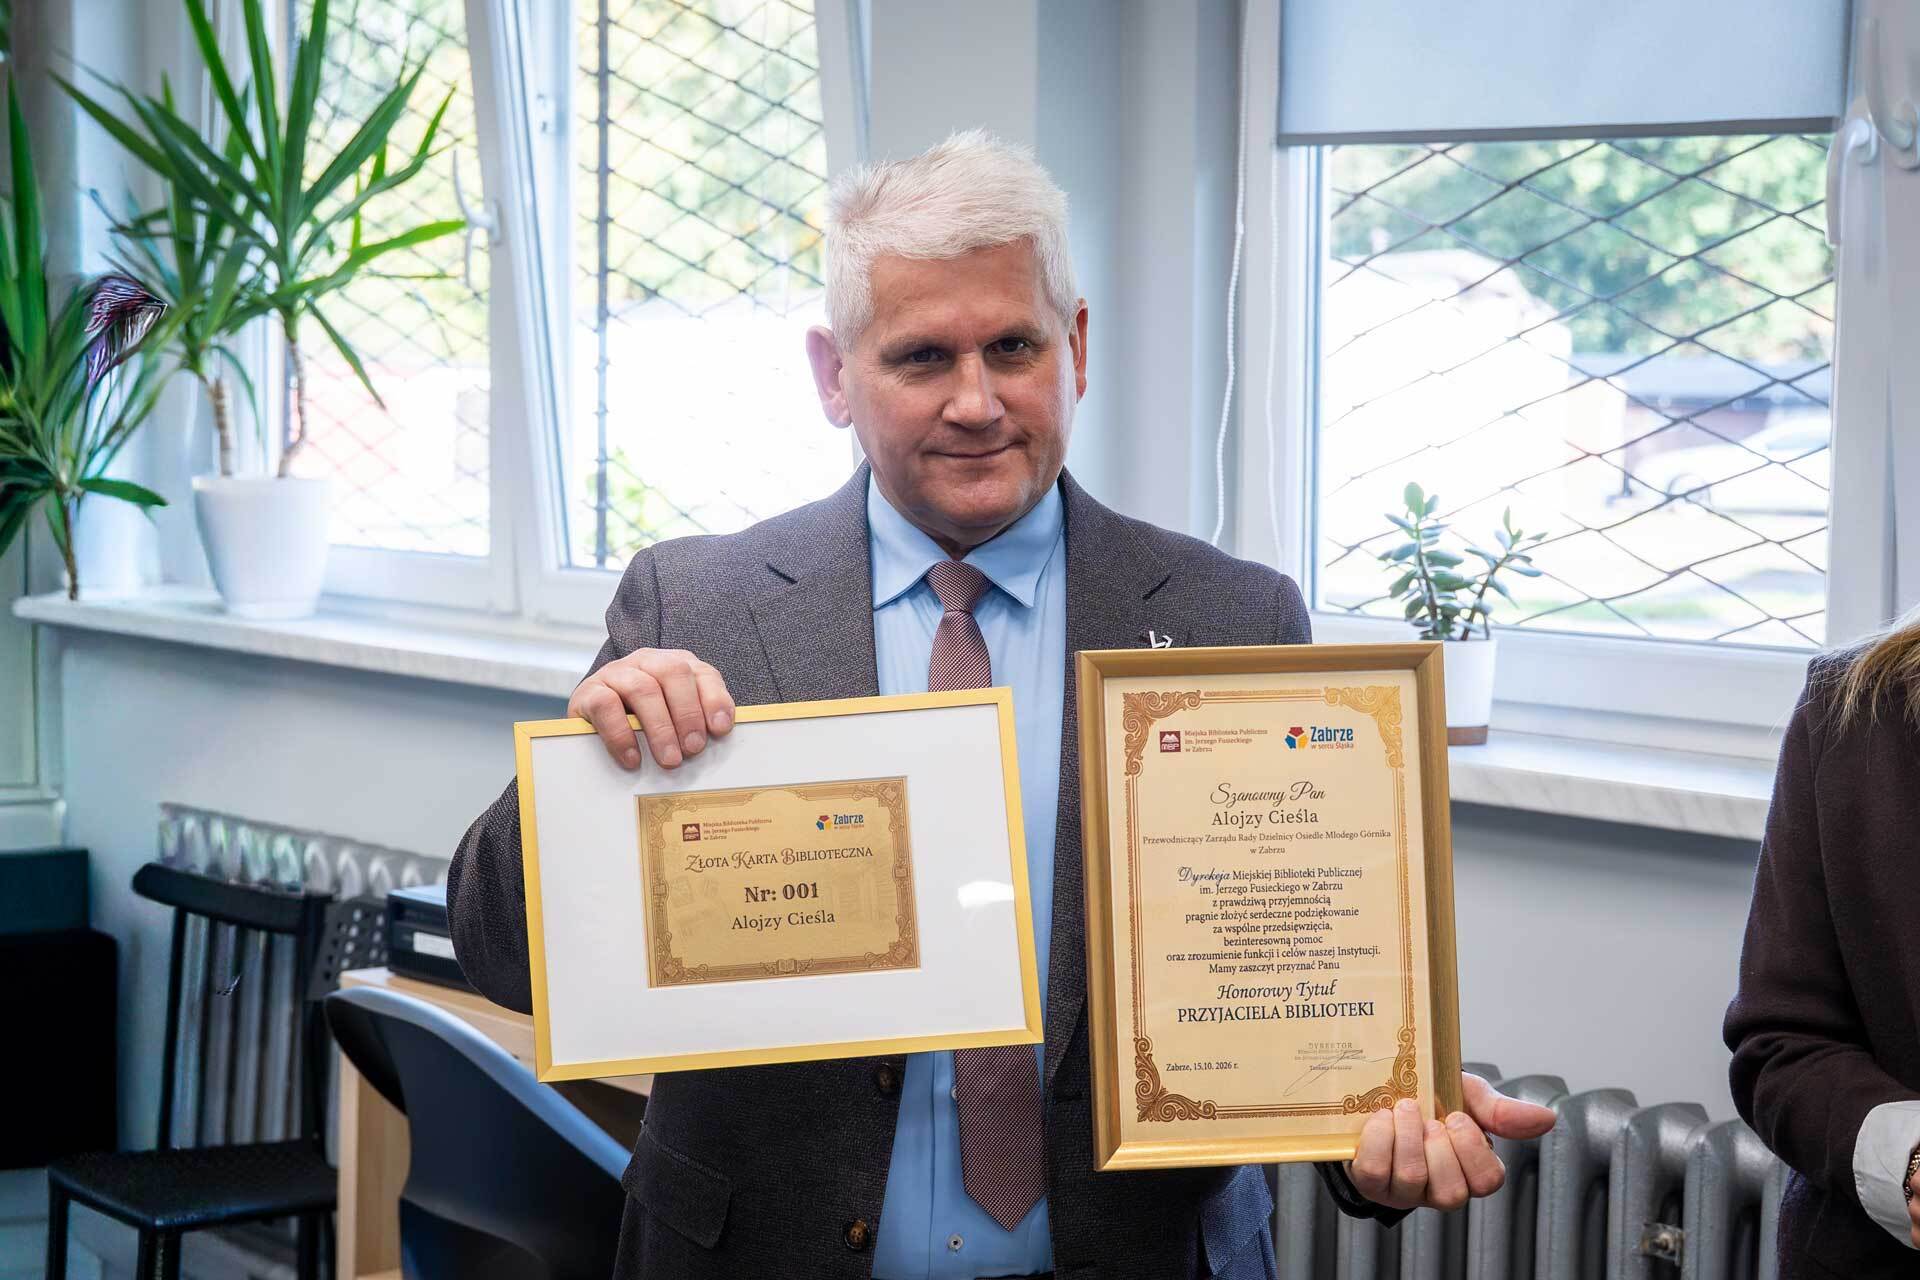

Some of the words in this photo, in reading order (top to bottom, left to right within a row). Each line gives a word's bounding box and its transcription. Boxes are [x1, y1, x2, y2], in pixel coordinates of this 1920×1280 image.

[1310, 726, 1354, 742] Zabrze
[1210, 782, 1286, 808] Szanowny
[1289, 781, 1326, 801] Pan
[833, 813, 864, 825] Zabrze
[1211, 810, 1263, 829] Alojzy
[1268, 808, 1319, 824] Cieśla
[1143, 835, 1204, 845] Przewodniczący
[1205, 834, 1237, 844] Zarządu
[1238, 833, 1257, 842] Rady
[1259, 832, 1293, 841] Dzielnicy
[1295, 831, 1324, 840] Osiedle
[1360, 830, 1391, 838] Górnika
[1259, 846, 1285, 854] Zabrzu
[1233, 870, 1272, 882] Miejskiej
[1274, 868, 1316, 879] Biblioteki
[1317, 867, 1362, 879] Publicznej
[744, 886, 777, 903] Nr:
[782, 882, 819, 900] 001
[1200, 885, 1214, 894] im.
[1216, 884, 1248, 896] Jerzego
[1312, 881, 1343, 891] Zabrzu
[1219, 897, 1266, 909] prawdziwą
[1268, 894, 1331, 908] przyjemnością
[731, 915, 782, 932] Alojzy
[787, 910, 835, 926] Cieśla
[1185, 911, 1219, 924] pragnie
[1249, 909, 1292, 920] serdeczne
[1294, 907, 1359, 920] podziękowanie
[1213, 926, 1223, 934] za
[1224, 922, 1261, 935] wspólne
[1224, 937, 1291, 947] bezinteresowną
[1293, 936, 1323, 946] pomoc
[1166, 953, 1186, 961] oraz
[1188, 950, 1242, 961] zrozumienie
[1244, 949, 1274, 960] funkcji
[1281, 948, 1307, 957] celów
[1309, 947, 1336, 958] naszej
[1337, 945, 1381, 958] Instytucji.
[1209, 963, 1237, 975] Mamy
[1239, 962, 1275, 974] zaszczyt
[1276, 960, 1316, 974] przyznać
[1318, 960, 1340, 970] Panu
[1217, 984, 1293, 1002] Honorowy
[1296, 979, 1338, 1001] Tytuł
[1177, 1004, 1282, 1024] PRZYJACIELA
[1285, 1001, 1375, 1019] BIBLIOTEKI
[1166, 1062, 1192, 1072] Zabrze,
